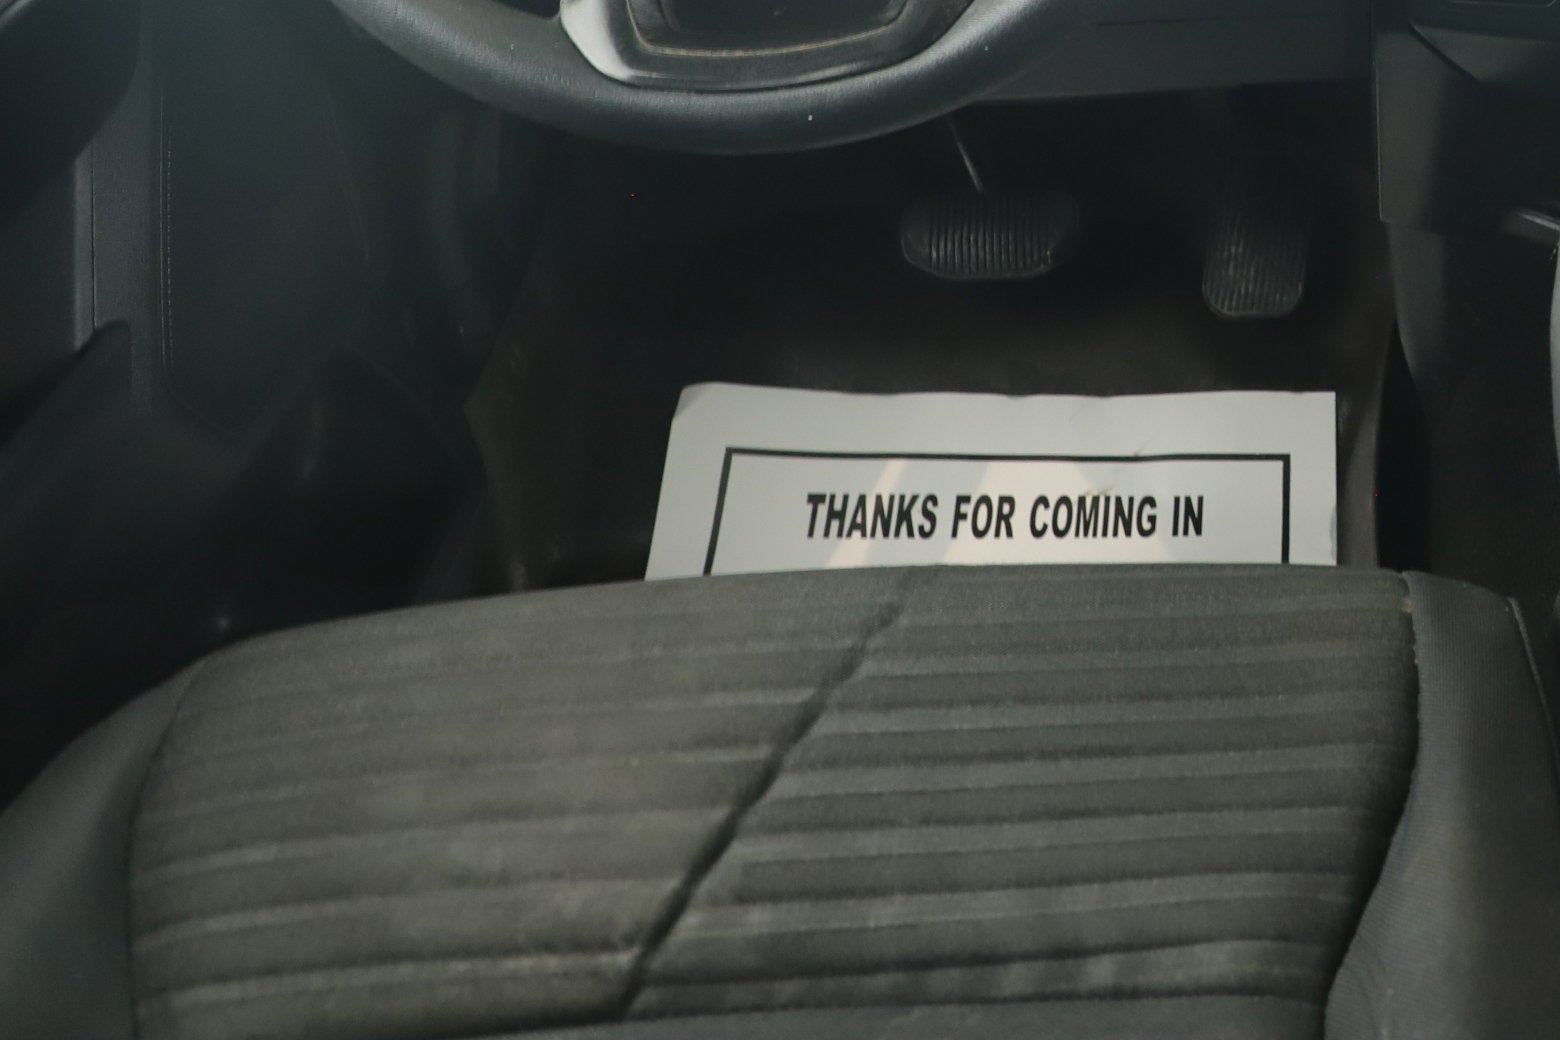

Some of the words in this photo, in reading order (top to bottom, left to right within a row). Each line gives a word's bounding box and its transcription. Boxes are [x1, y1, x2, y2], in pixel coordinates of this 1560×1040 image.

[806, 493, 939, 538] THANKS
[951, 495, 1015, 538] FOR
[1029, 495, 1158, 539] COMING
[1172, 496, 1204, 537] IN
